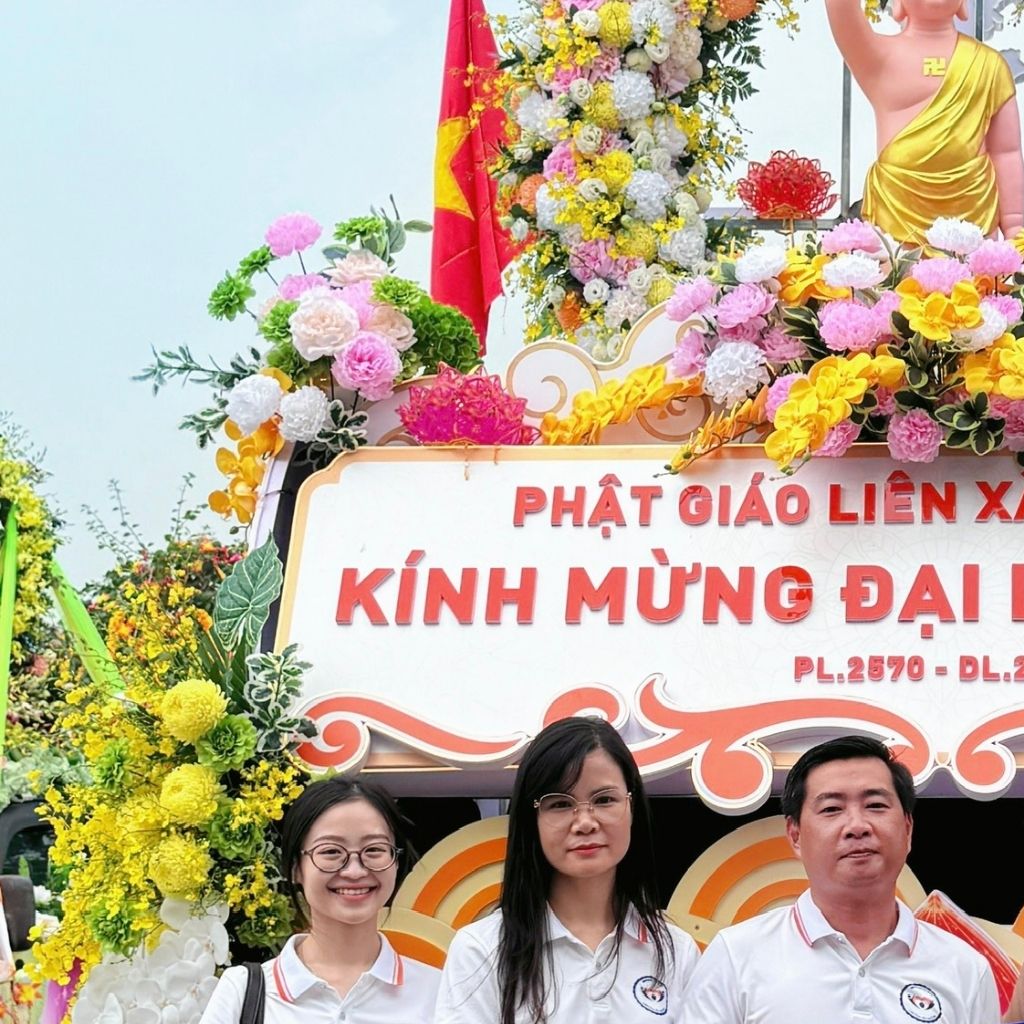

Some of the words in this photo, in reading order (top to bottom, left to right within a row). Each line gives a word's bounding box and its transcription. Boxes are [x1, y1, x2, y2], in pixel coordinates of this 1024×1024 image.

[513, 473, 662, 538] PHẬT
[678, 472, 811, 526] GIÁO
[828, 470, 957, 525] LIÊN
[335, 549, 537, 625] KÍNH
[564, 547, 814, 625] MỪNG
[840, 563, 981, 639] ĐẠI
[794, 655, 925, 683] PL.2570
